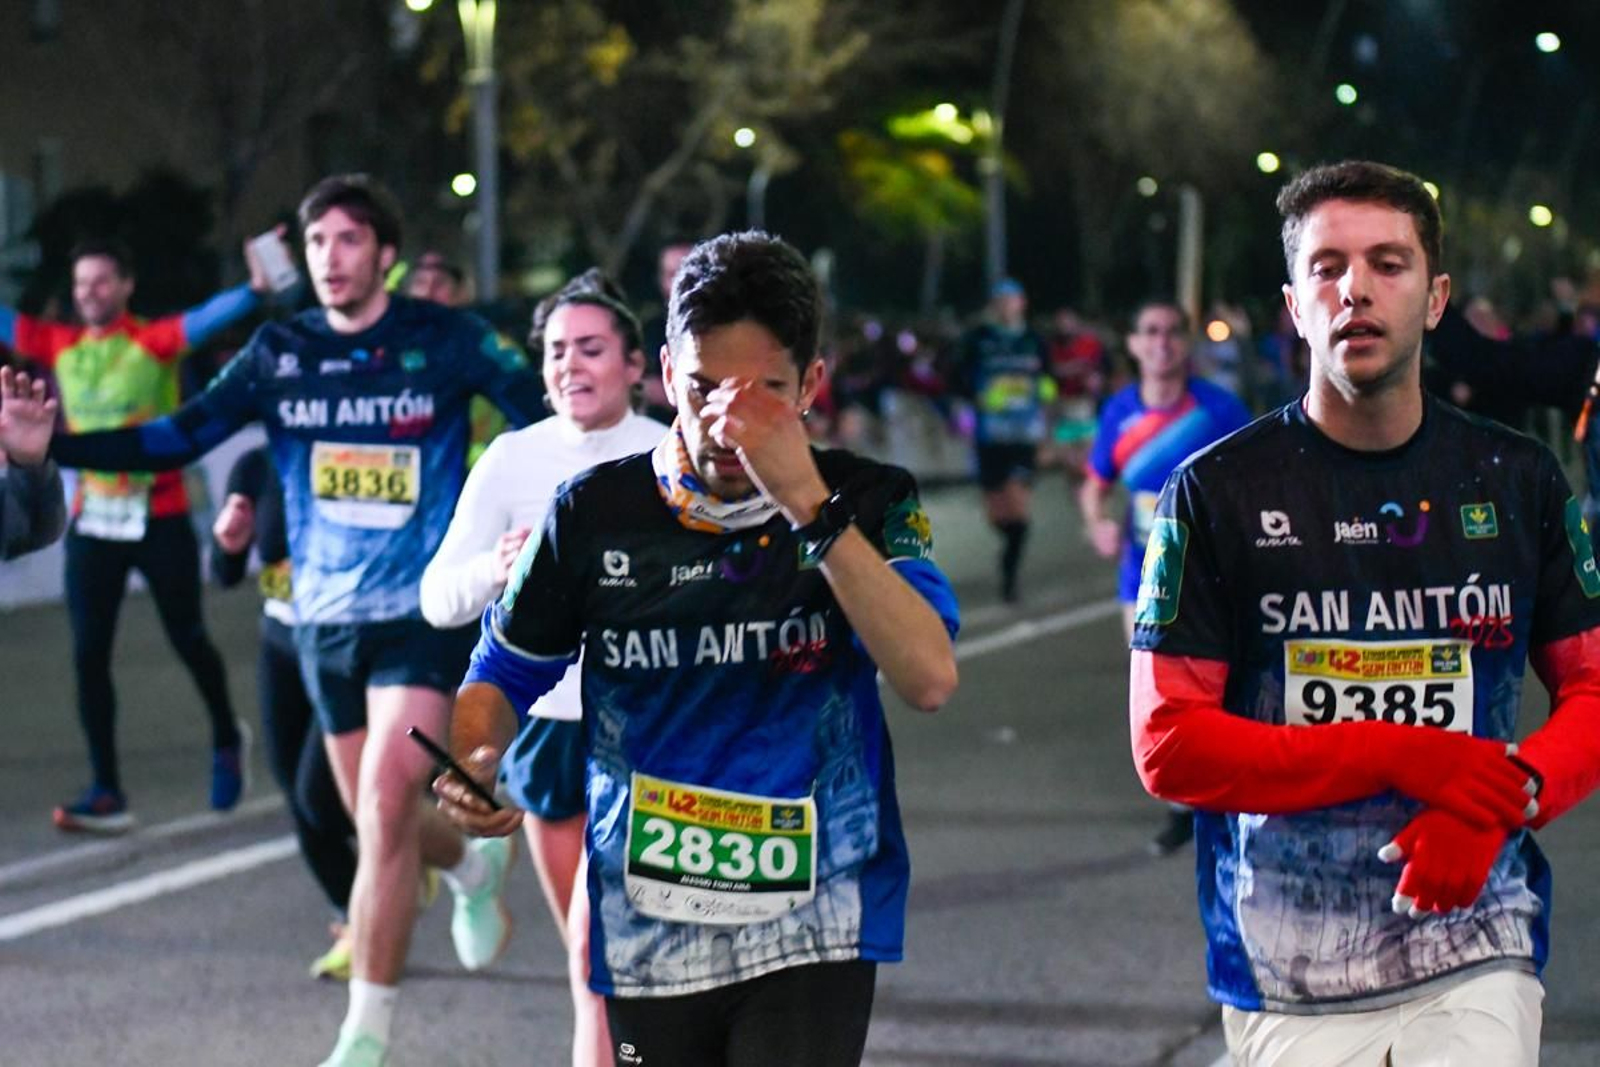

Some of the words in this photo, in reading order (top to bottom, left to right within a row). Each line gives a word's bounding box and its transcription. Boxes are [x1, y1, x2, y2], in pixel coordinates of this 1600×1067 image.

[278, 399, 328, 428] SAN
[335, 388, 435, 427] ANTÓN
[320, 466, 408, 498] 3836
[1259, 590, 1350, 634] SAN
[1364, 573, 1512, 631] ANTÓN
[602, 627, 680, 670] SAN
[1450, 614, 1515, 649] 2025
[1328, 648, 1362, 675] 42
[1301, 680, 1456, 729] 9385
[668, 788, 698, 817] 42
[639, 818, 799, 881] 2830
